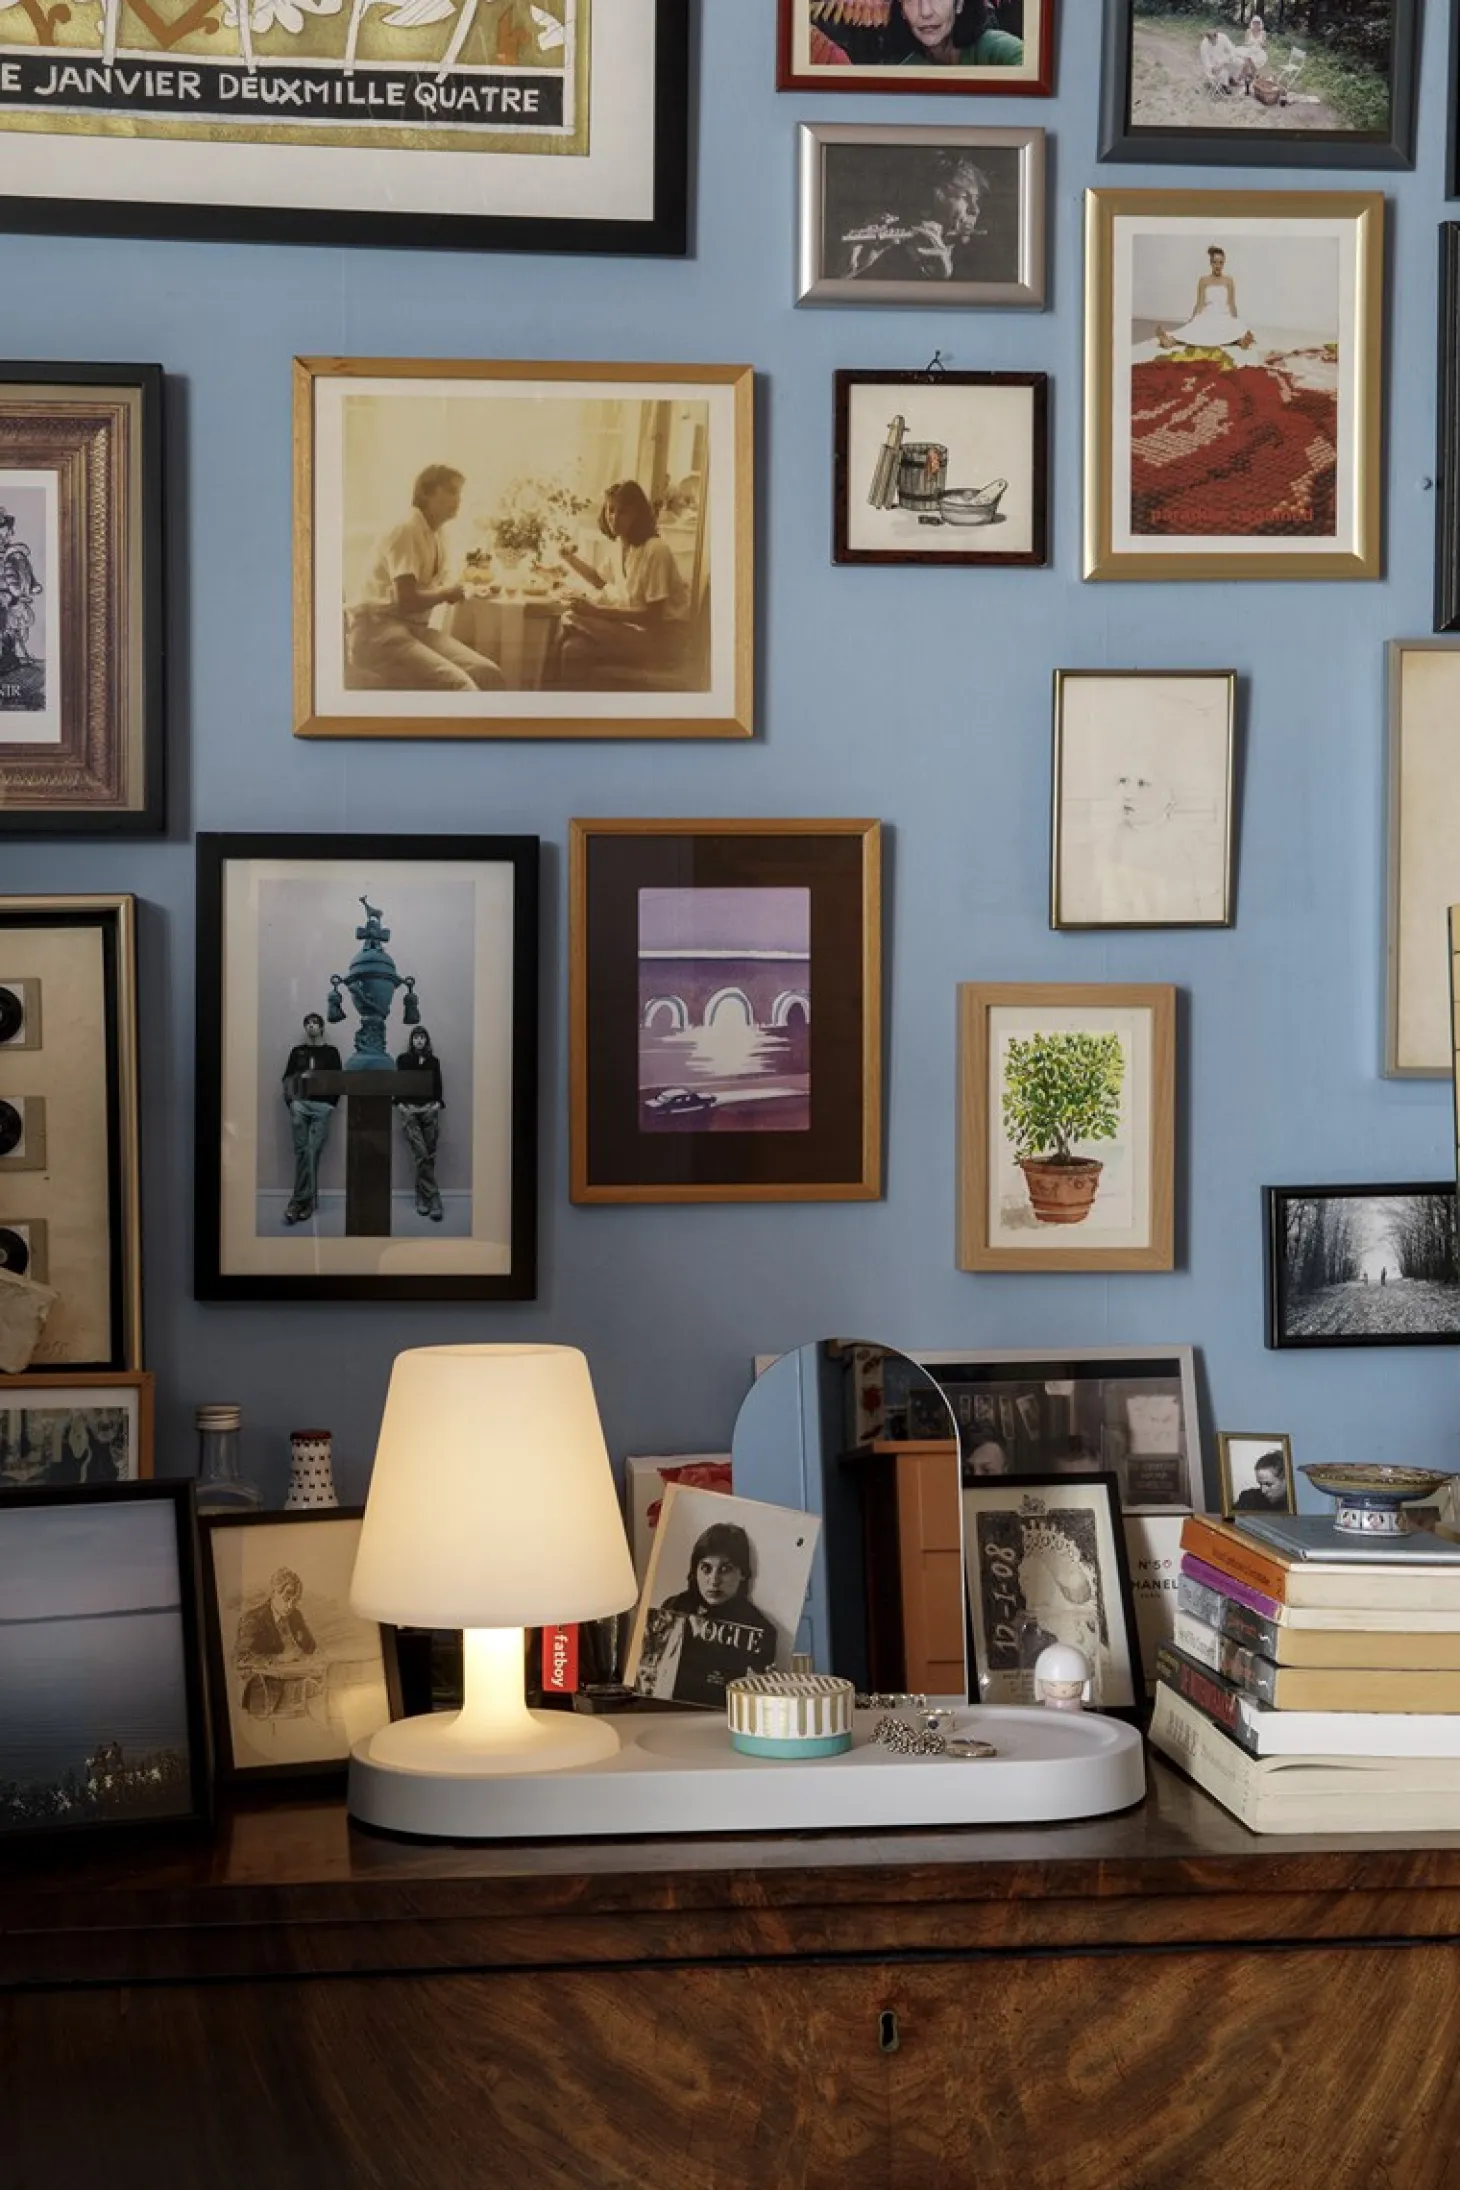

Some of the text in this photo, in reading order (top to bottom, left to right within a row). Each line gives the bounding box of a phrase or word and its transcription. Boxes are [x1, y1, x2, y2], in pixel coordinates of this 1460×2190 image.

[34, 65, 201, 99] JANVIER
[414, 82, 540, 113] QUATRE
[1131, 1578, 1179, 1590] HANEL
[688, 1615, 764, 1654] VOGUE
[551, 1634, 569, 1687] fatboy
